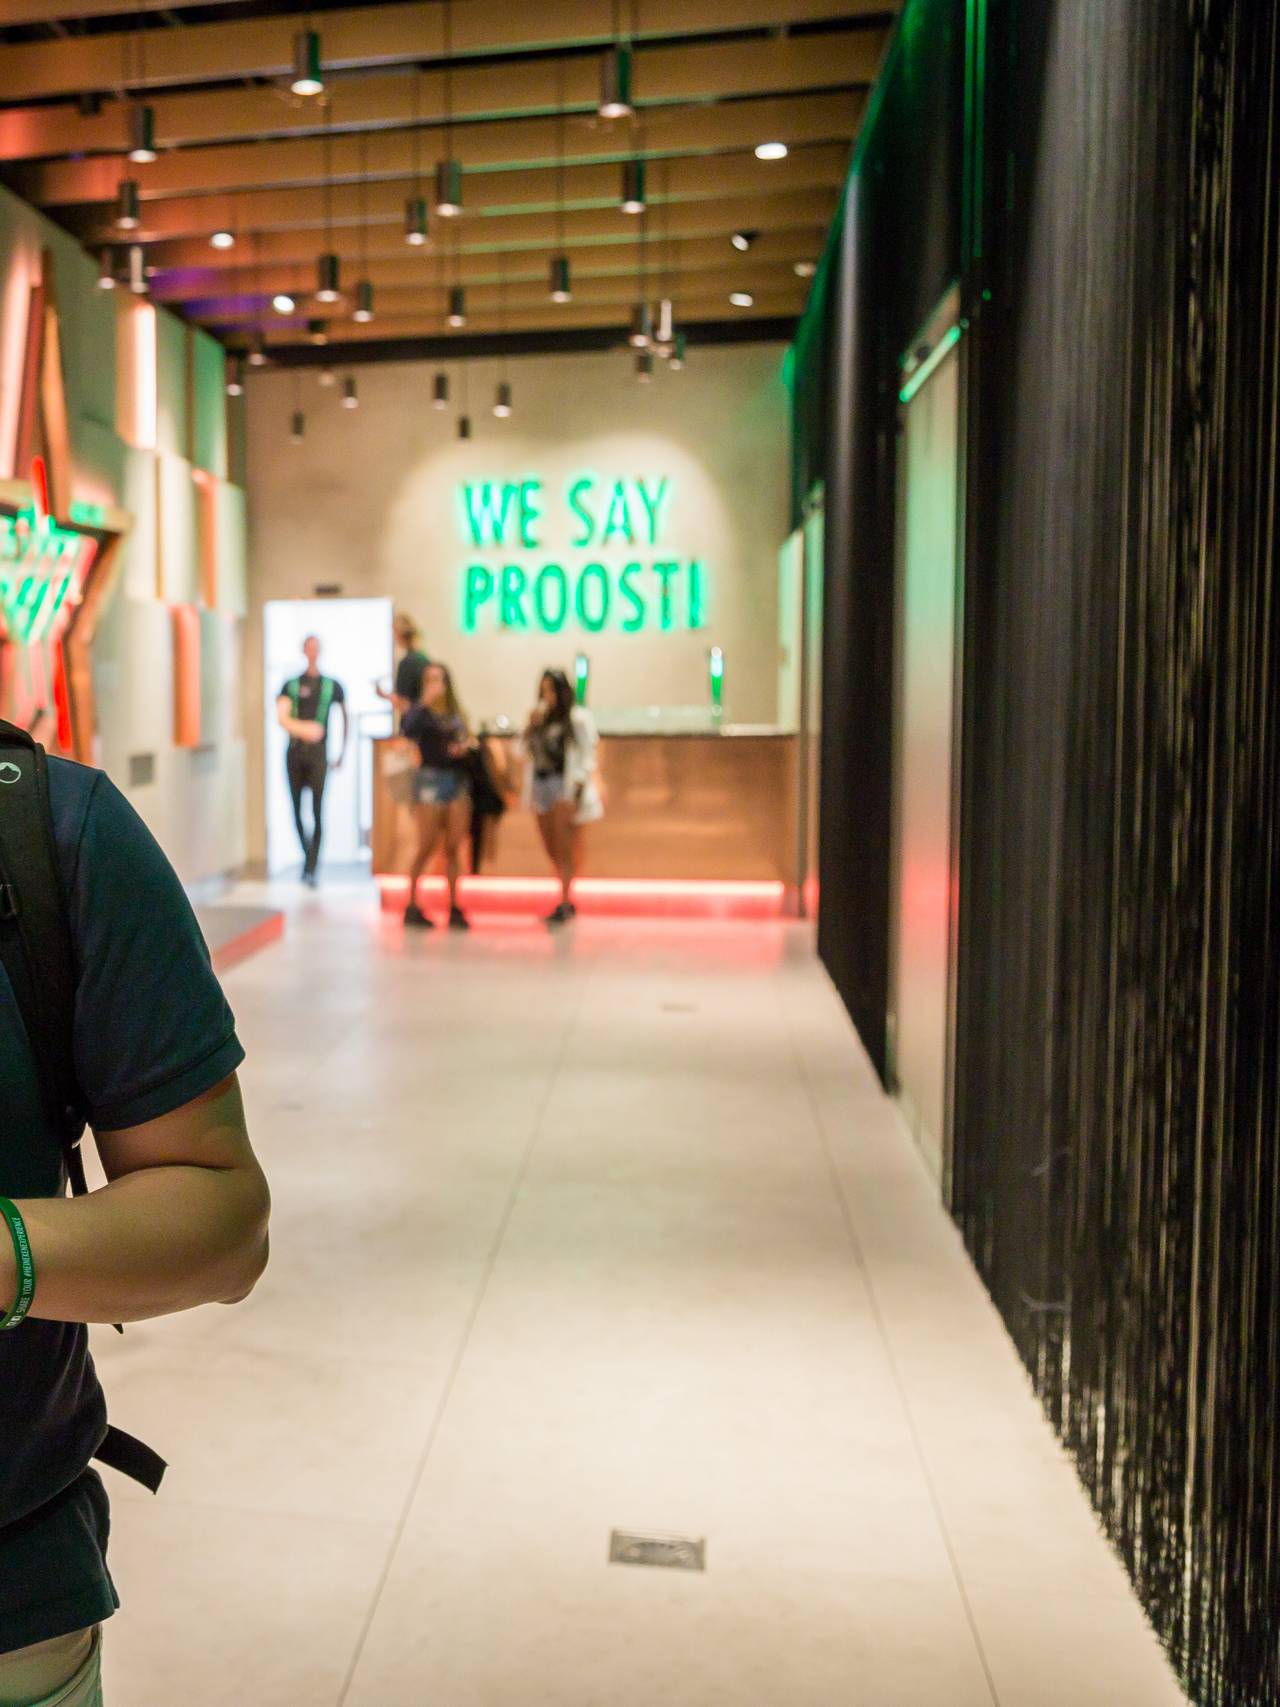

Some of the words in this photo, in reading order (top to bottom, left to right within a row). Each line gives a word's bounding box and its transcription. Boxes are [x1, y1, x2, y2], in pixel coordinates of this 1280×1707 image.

[462, 477, 541, 549] WE
[568, 475, 669, 549] SAY
[463, 558, 705, 634] PROOST!
[22, 1278, 32, 1296] YOUR
